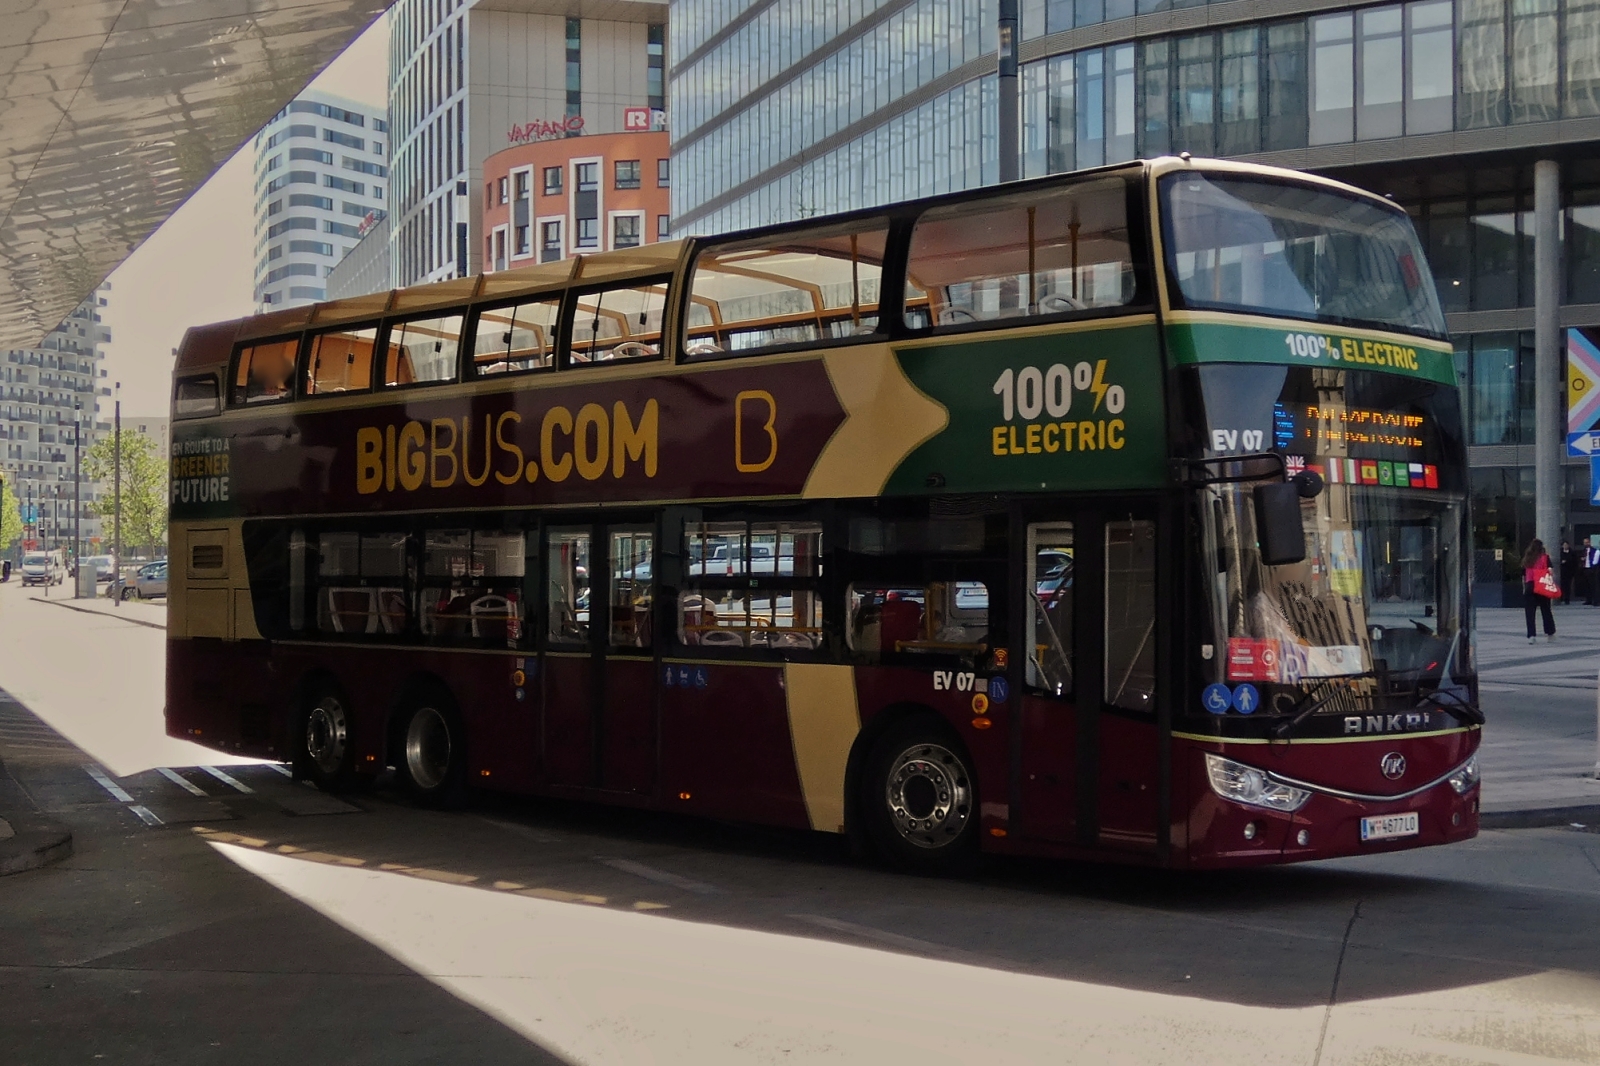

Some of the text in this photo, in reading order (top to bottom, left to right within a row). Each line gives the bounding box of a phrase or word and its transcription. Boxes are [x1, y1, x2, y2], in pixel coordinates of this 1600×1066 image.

[1285, 333, 1419, 370] 100% ELECTRIC
[992, 359, 1126, 421] 100%
[735, 389, 779, 473] B
[992, 418, 1126, 456] ELECTRIC
[1212, 429, 1264, 451] EV 07
[1592, 437, 1600, 448] E
[172, 437, 230, 455] EN ROUTE TO A
[356, 398, 659, 495] BIGBUS.COM
[172, 453, 230, 478] GREENER
[172, 476, 230, 504] FUTURE
[933, 670, 975, 692] EV 07
